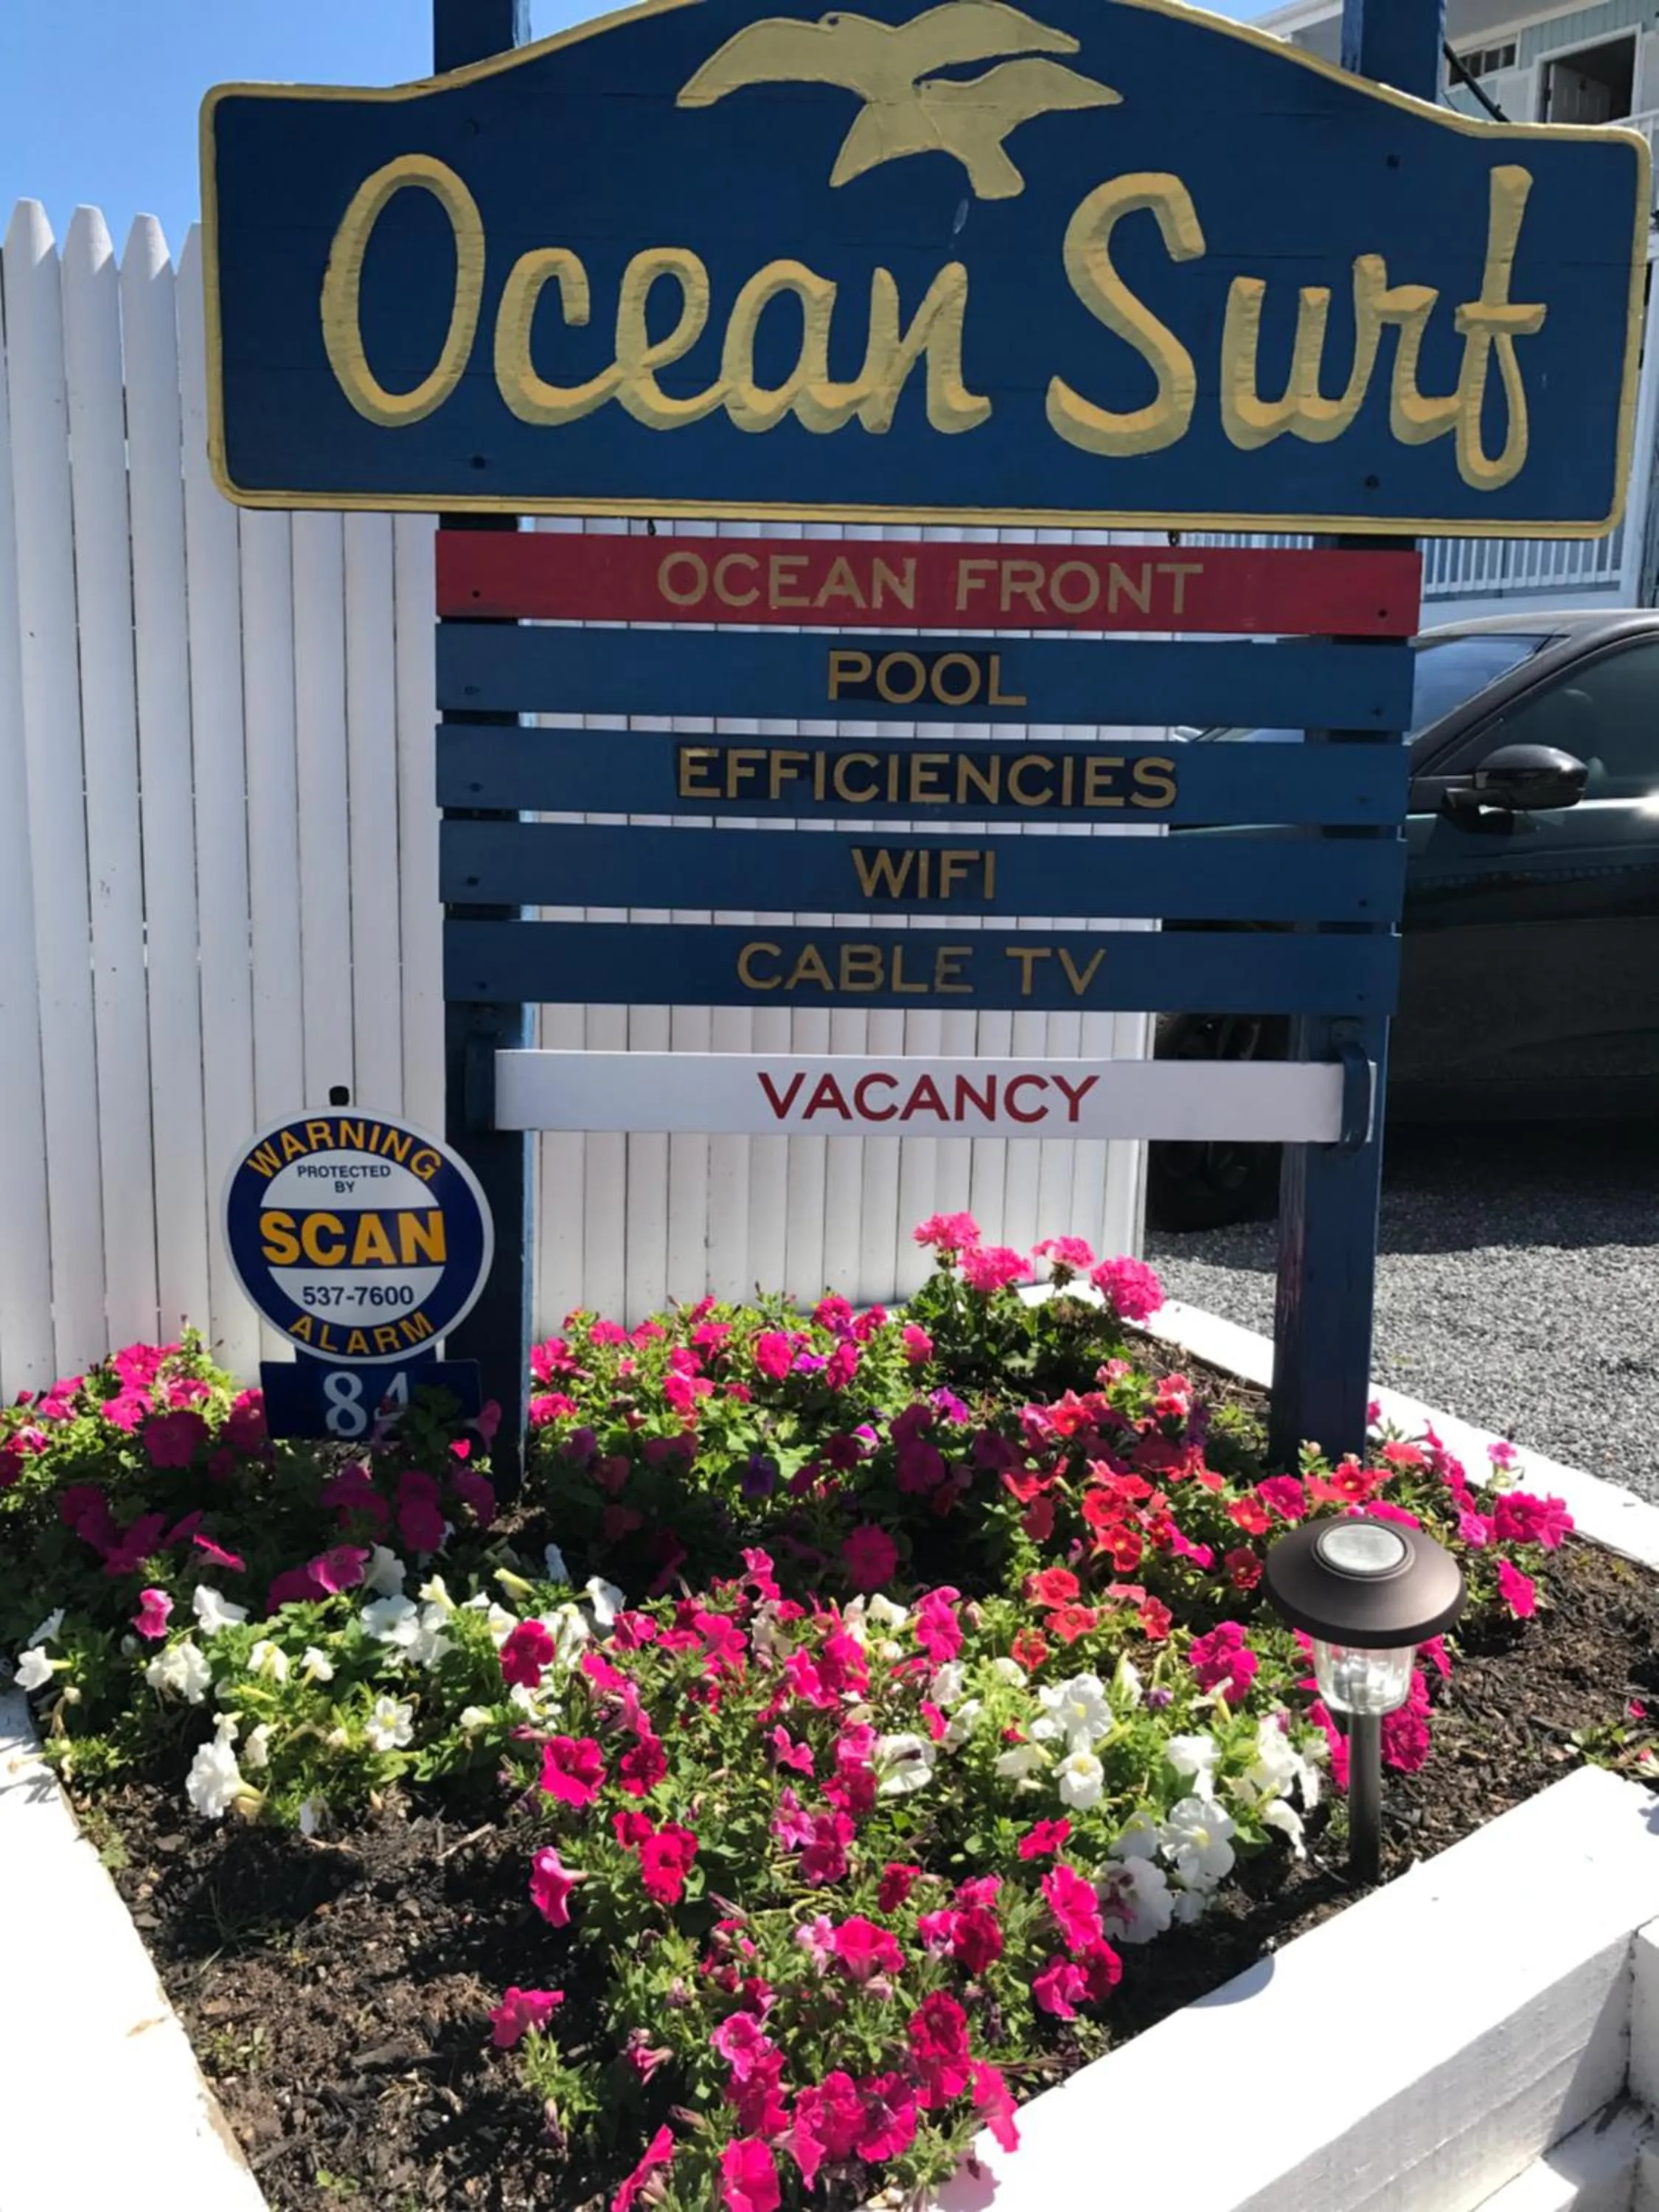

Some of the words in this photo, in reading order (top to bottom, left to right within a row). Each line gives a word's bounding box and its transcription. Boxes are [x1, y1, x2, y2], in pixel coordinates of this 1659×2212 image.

[320, 153, 992, 434] Ocean
[1046, 164, 1546, 490] Surf
[657, 552, 917, 610] OCEAN
[955, 558, 1204, 614] FRONT
[827, 650, 1026, 706] POOL
[678, 747, 1179, 809] EFFICIENCIES
[851, 848, 995, 900] WIFI
[737, 942, 974, 994] CABLE
[1006, 947, 1107, 996] TV
[757, 1072, 1101, 1123] VACANCY
[247, 1120, 442, 1181] WARNING
[297, 1164, 391, 1179] PROTECTED
[334, 1181, 356, 1193] BY
[260, 1210, 447, 1267] SCAN
[302, 1285, 414, 1307] 537-7600
[289, 1312, 434, 1354] ALARM
